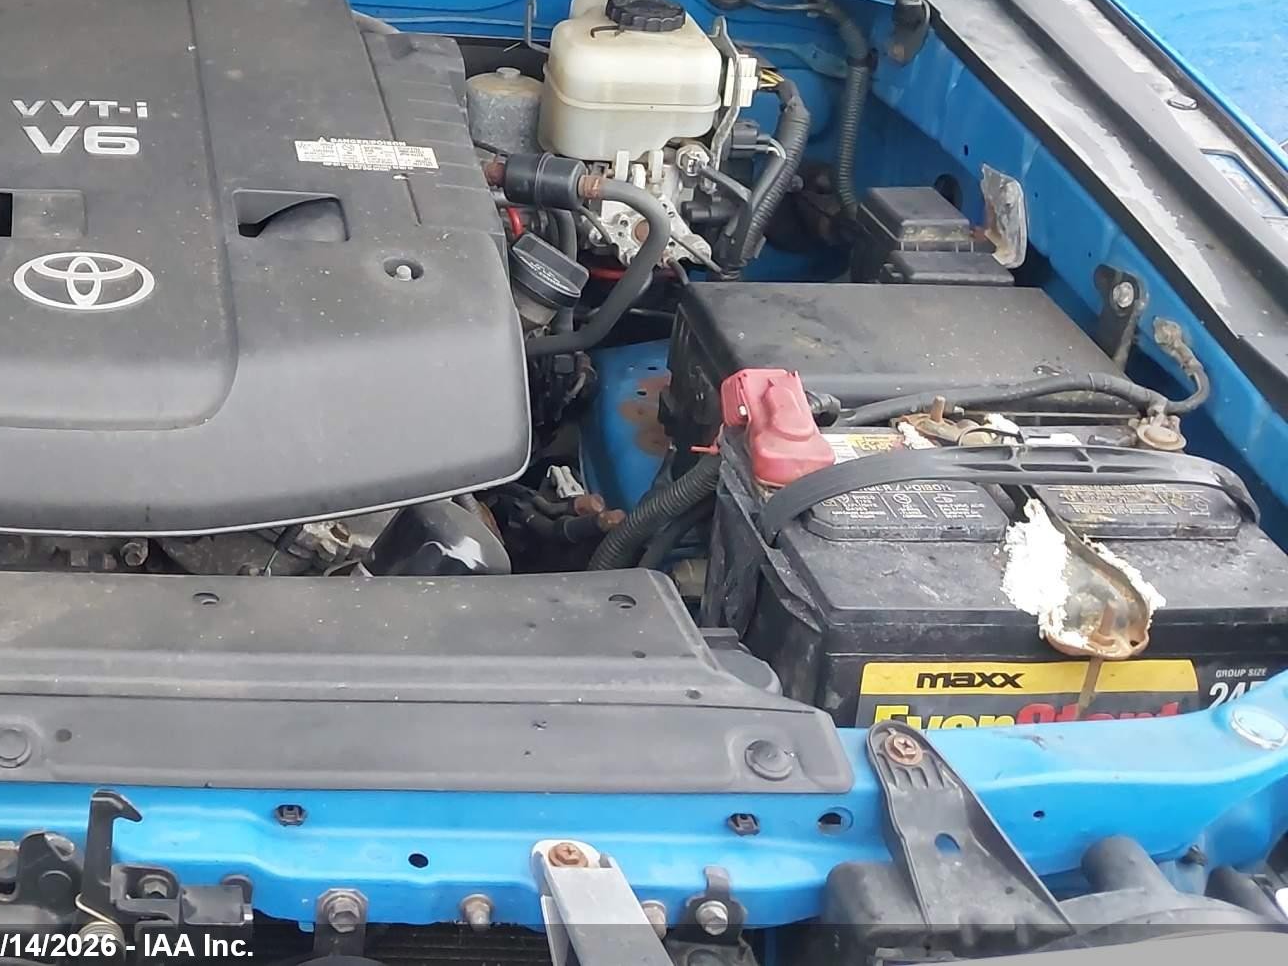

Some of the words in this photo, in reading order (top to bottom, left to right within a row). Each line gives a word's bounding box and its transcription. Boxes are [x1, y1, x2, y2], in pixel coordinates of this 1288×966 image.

[12, 99, 149, 117] VVT-i
[22, 125, 140, 155] V6
[916, 670, 1025, 690] maxx
[1215, 668, 1247, 679] GROUP
[1247, 667, 1269, 677] SIZE
